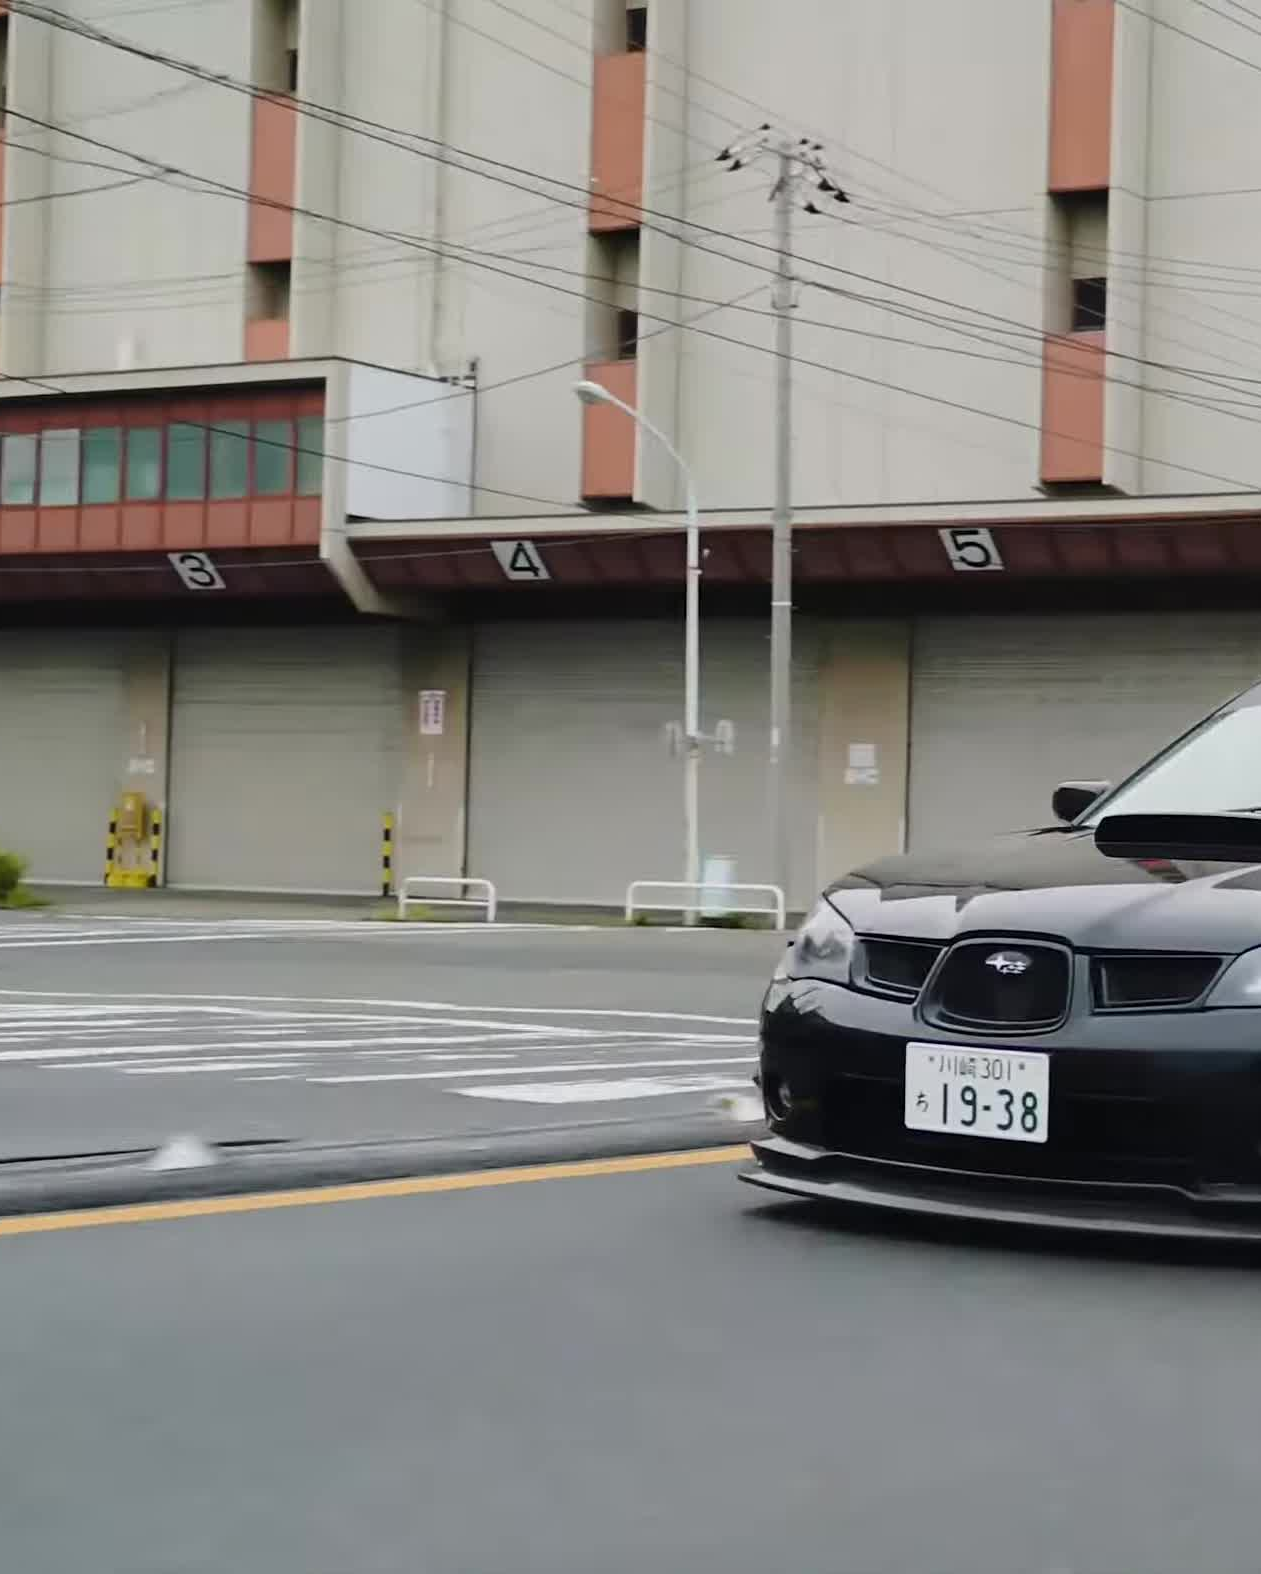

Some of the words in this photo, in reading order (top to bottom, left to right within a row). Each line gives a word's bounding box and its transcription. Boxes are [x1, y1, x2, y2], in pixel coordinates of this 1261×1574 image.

[509, 542, 540, 577] 4
[950, 529, 992, 568] 5
[180, 554, 216, 587] 3
[915, 1090, 929, 1113] ち
[942, 1082, 1038, 1133] 19-38
